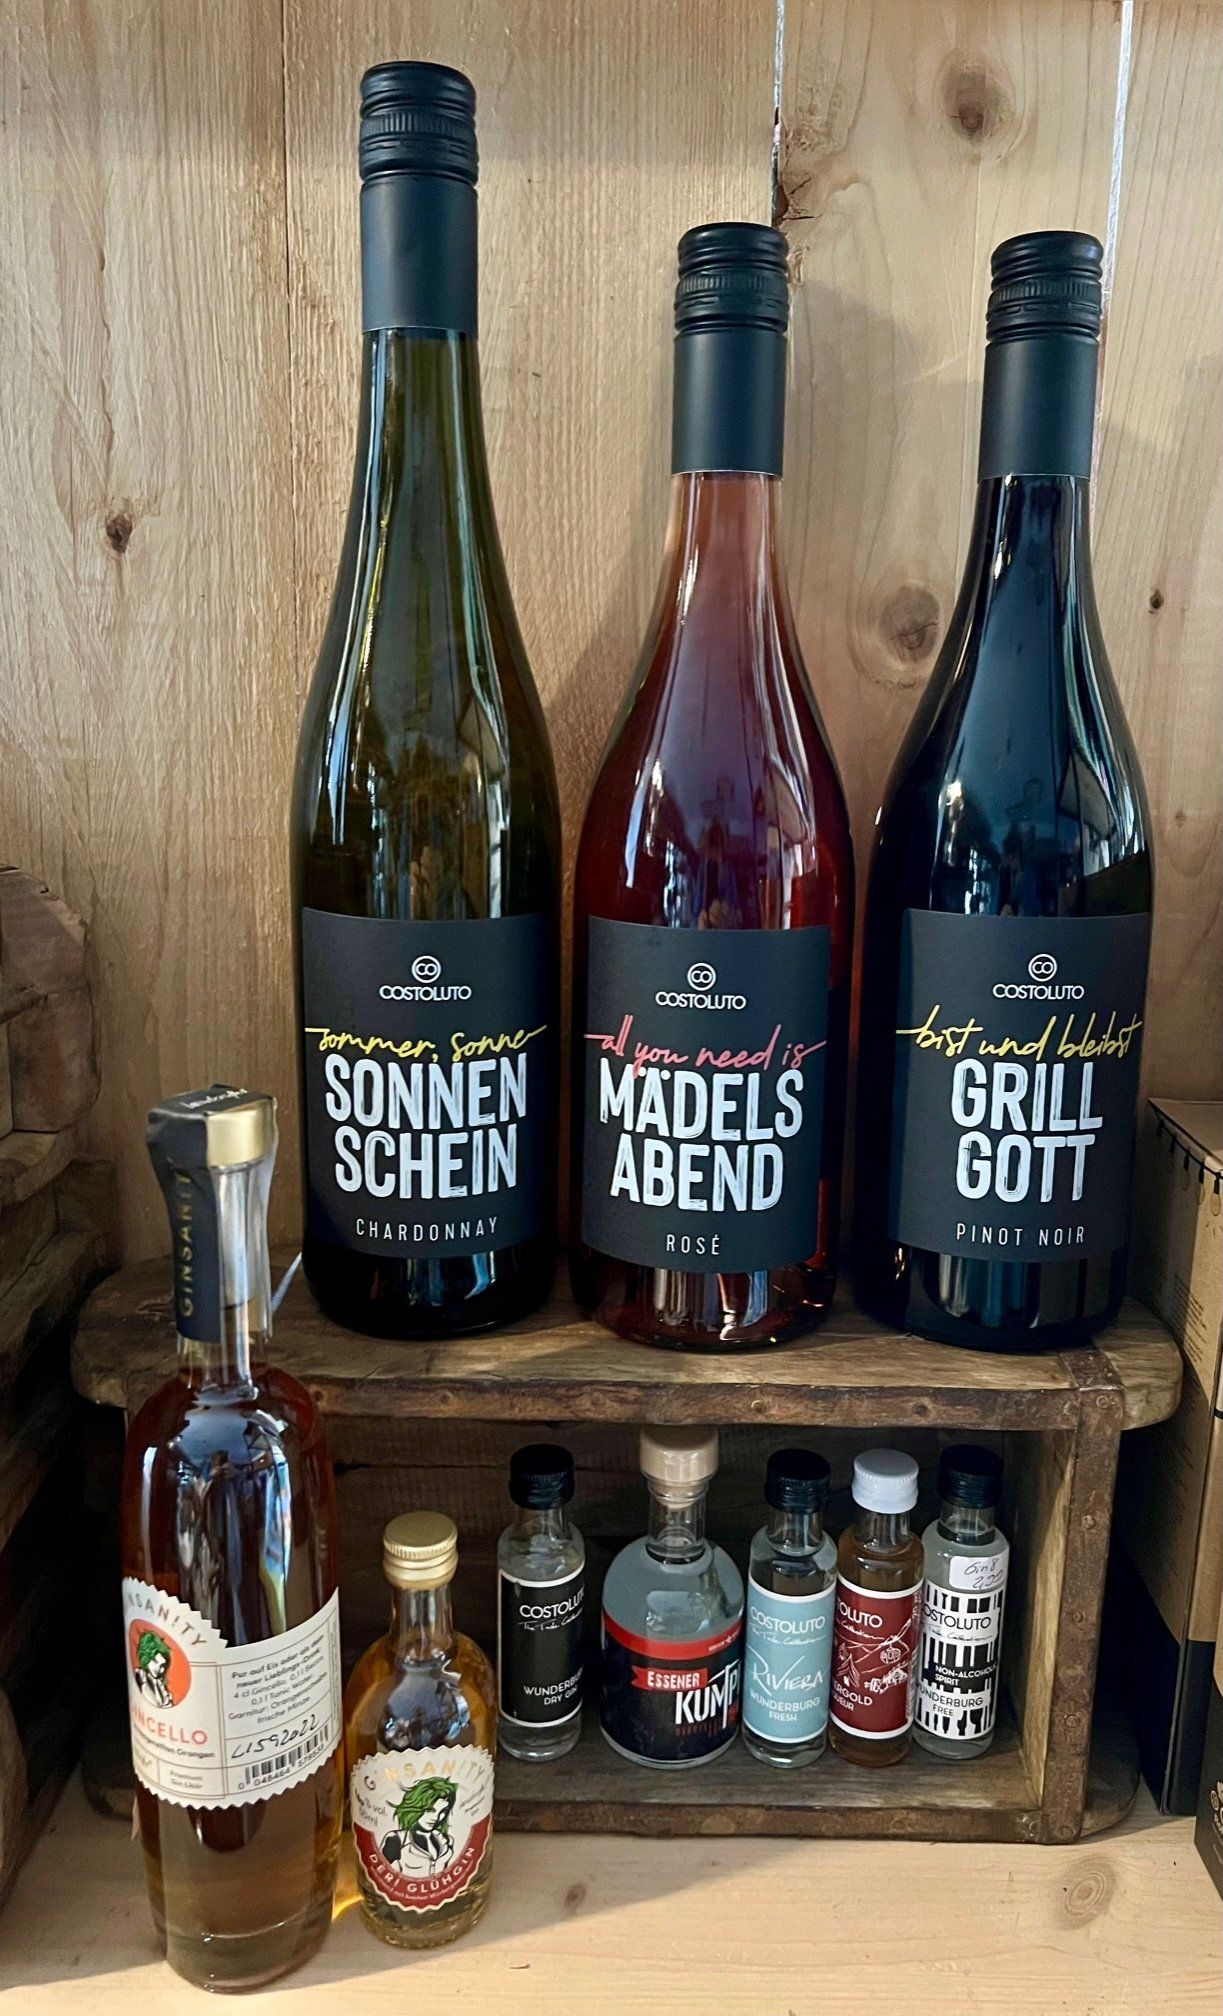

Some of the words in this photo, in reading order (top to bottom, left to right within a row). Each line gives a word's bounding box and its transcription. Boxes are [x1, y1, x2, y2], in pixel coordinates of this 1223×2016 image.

[379, 985, 472, 1001] COSTOLUTO
[655, 991, 747, 1010] COSTOLUTO
[992, 983, 1085, 1000] COSTOLUTO
[896, 1004, 984, 1057] bist
[978, 1016, 1057, 1062] und
[1057, 1011, 1143, 1058] bleibst
[584, 1014, 634, 1057] all
[631, 1041, 689, 1080] you
[695, 1024, 782, 1071] need
[782, 1039, 827, 1069] is
[325, 1052, 527, 1130] SONNEN
[600, 1057, 804, 1141] MÄDELS
[951, 1058, 1103, 1132] GRILL
[335, 1123, 517, 1199] SCHEIN
[610, 1133, 783, 1212] ABEND
[956, 1131, 1096, 1203] GOTT
[356, 1217, 498, 1242] CHARDONNAY
[956, 1223, 1023, 1246] PINOT
[1039, 1226, 1085, 1246] NOIR
[666, 1234, 720, 1256] ROSÉ
[519, 1585, 585, 1619] COSTOLUT
[750, 1606, 826, 1634] COSTOLUTO
[232, 1671, 247, 1679] Pur
[250, 1665, 265, 1675] auf
[647, 1671, 700, 1690] ESSENER
[934, 1673, 960, 1686] SPIRIT
[543, 1693, 563, 1706] DRY
[750, 1688, 820, 1712] WUNDERBURG
[920, 1685, 983, 1708] UNDERBURG
[769, 1711, 798, 1722] FRESH
[933, 1703, 954, 1716] FREE
